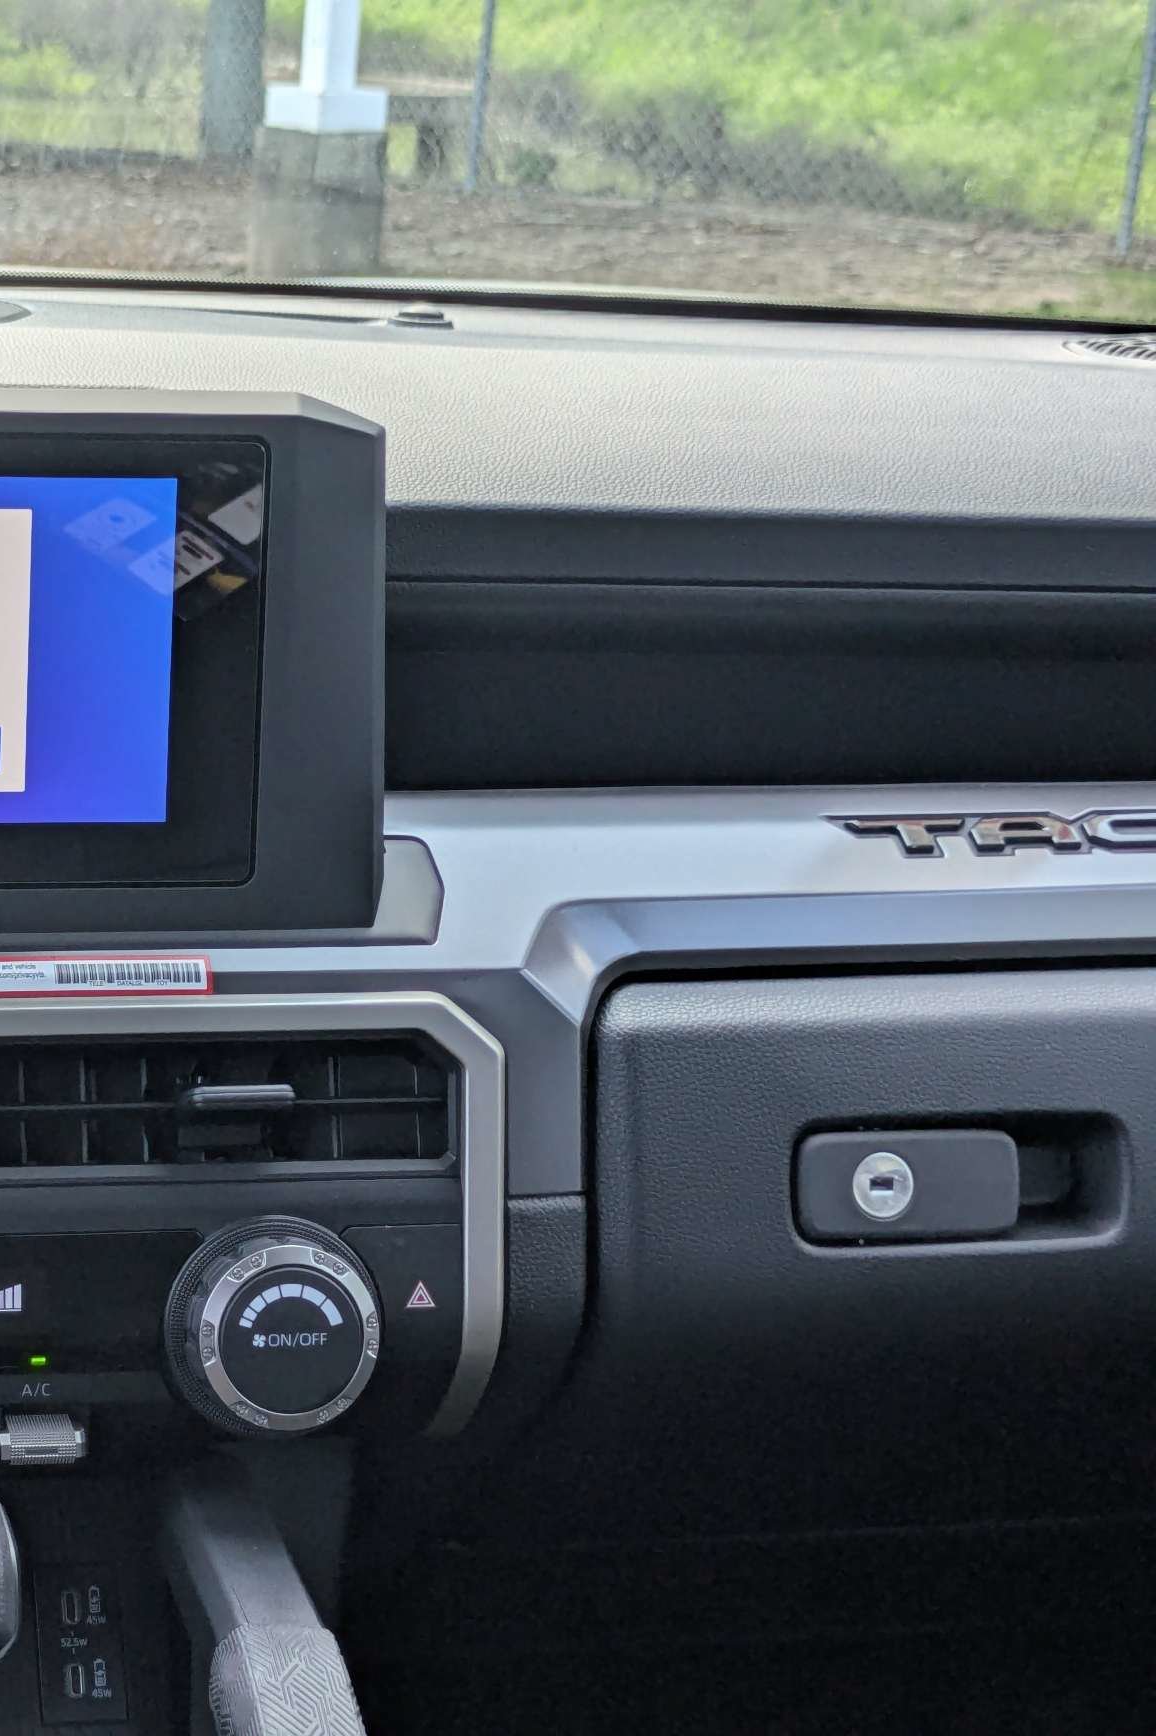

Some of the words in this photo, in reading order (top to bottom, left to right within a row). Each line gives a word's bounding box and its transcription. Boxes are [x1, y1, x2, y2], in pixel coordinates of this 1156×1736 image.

[268, 1332, 328, 1347] ON/OFF
[21, 1383, 51, 1398] A/C
[92, 1688, 112, 1699] 45W
